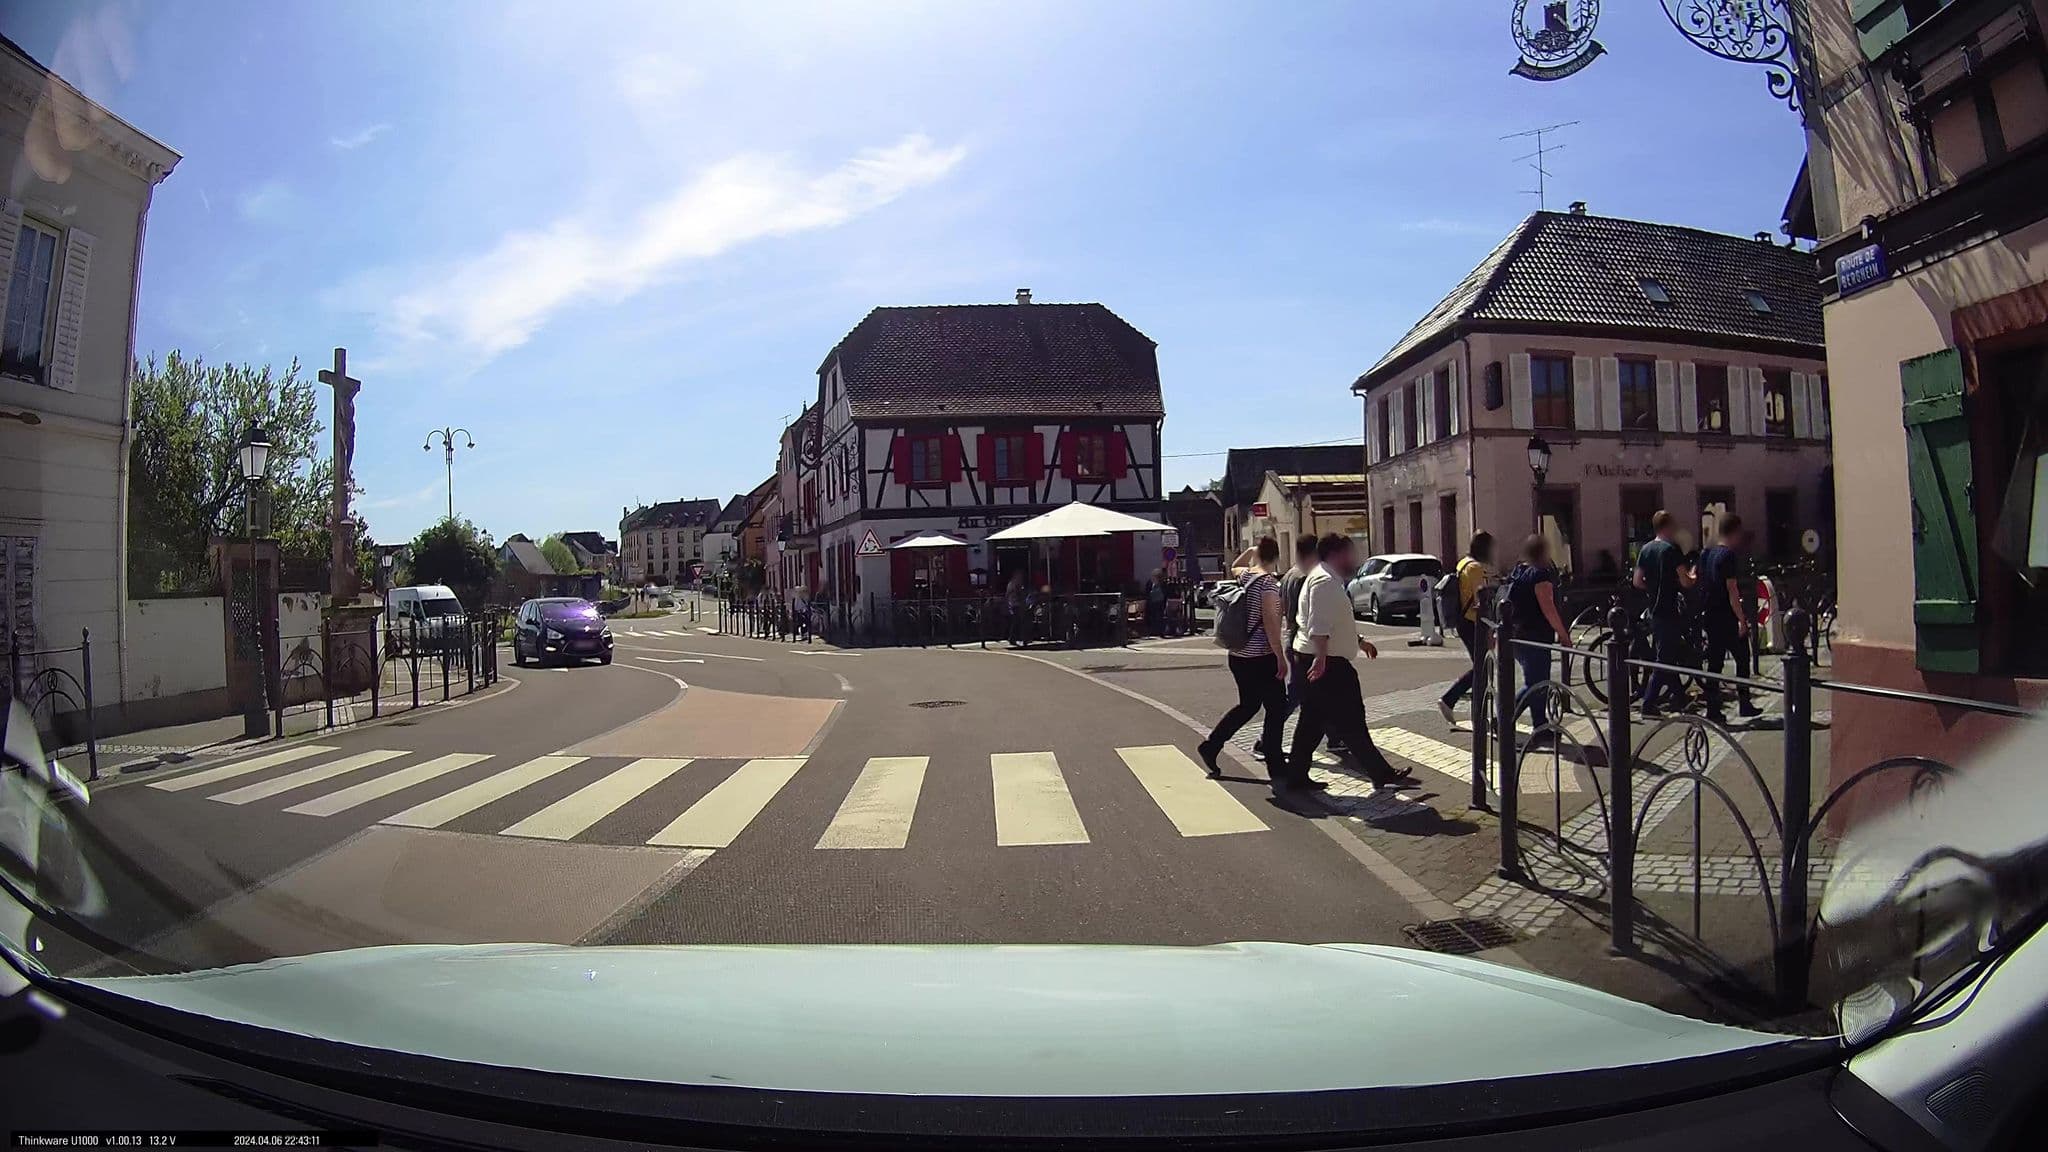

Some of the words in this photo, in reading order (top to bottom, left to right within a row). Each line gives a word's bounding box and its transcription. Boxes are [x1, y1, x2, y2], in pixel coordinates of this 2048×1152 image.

[1840, 255, 1863, 271] ROUTE
[1864, 249, 1875, 262] DE
[1841, 263, 1879, 288] BERGHEIM
